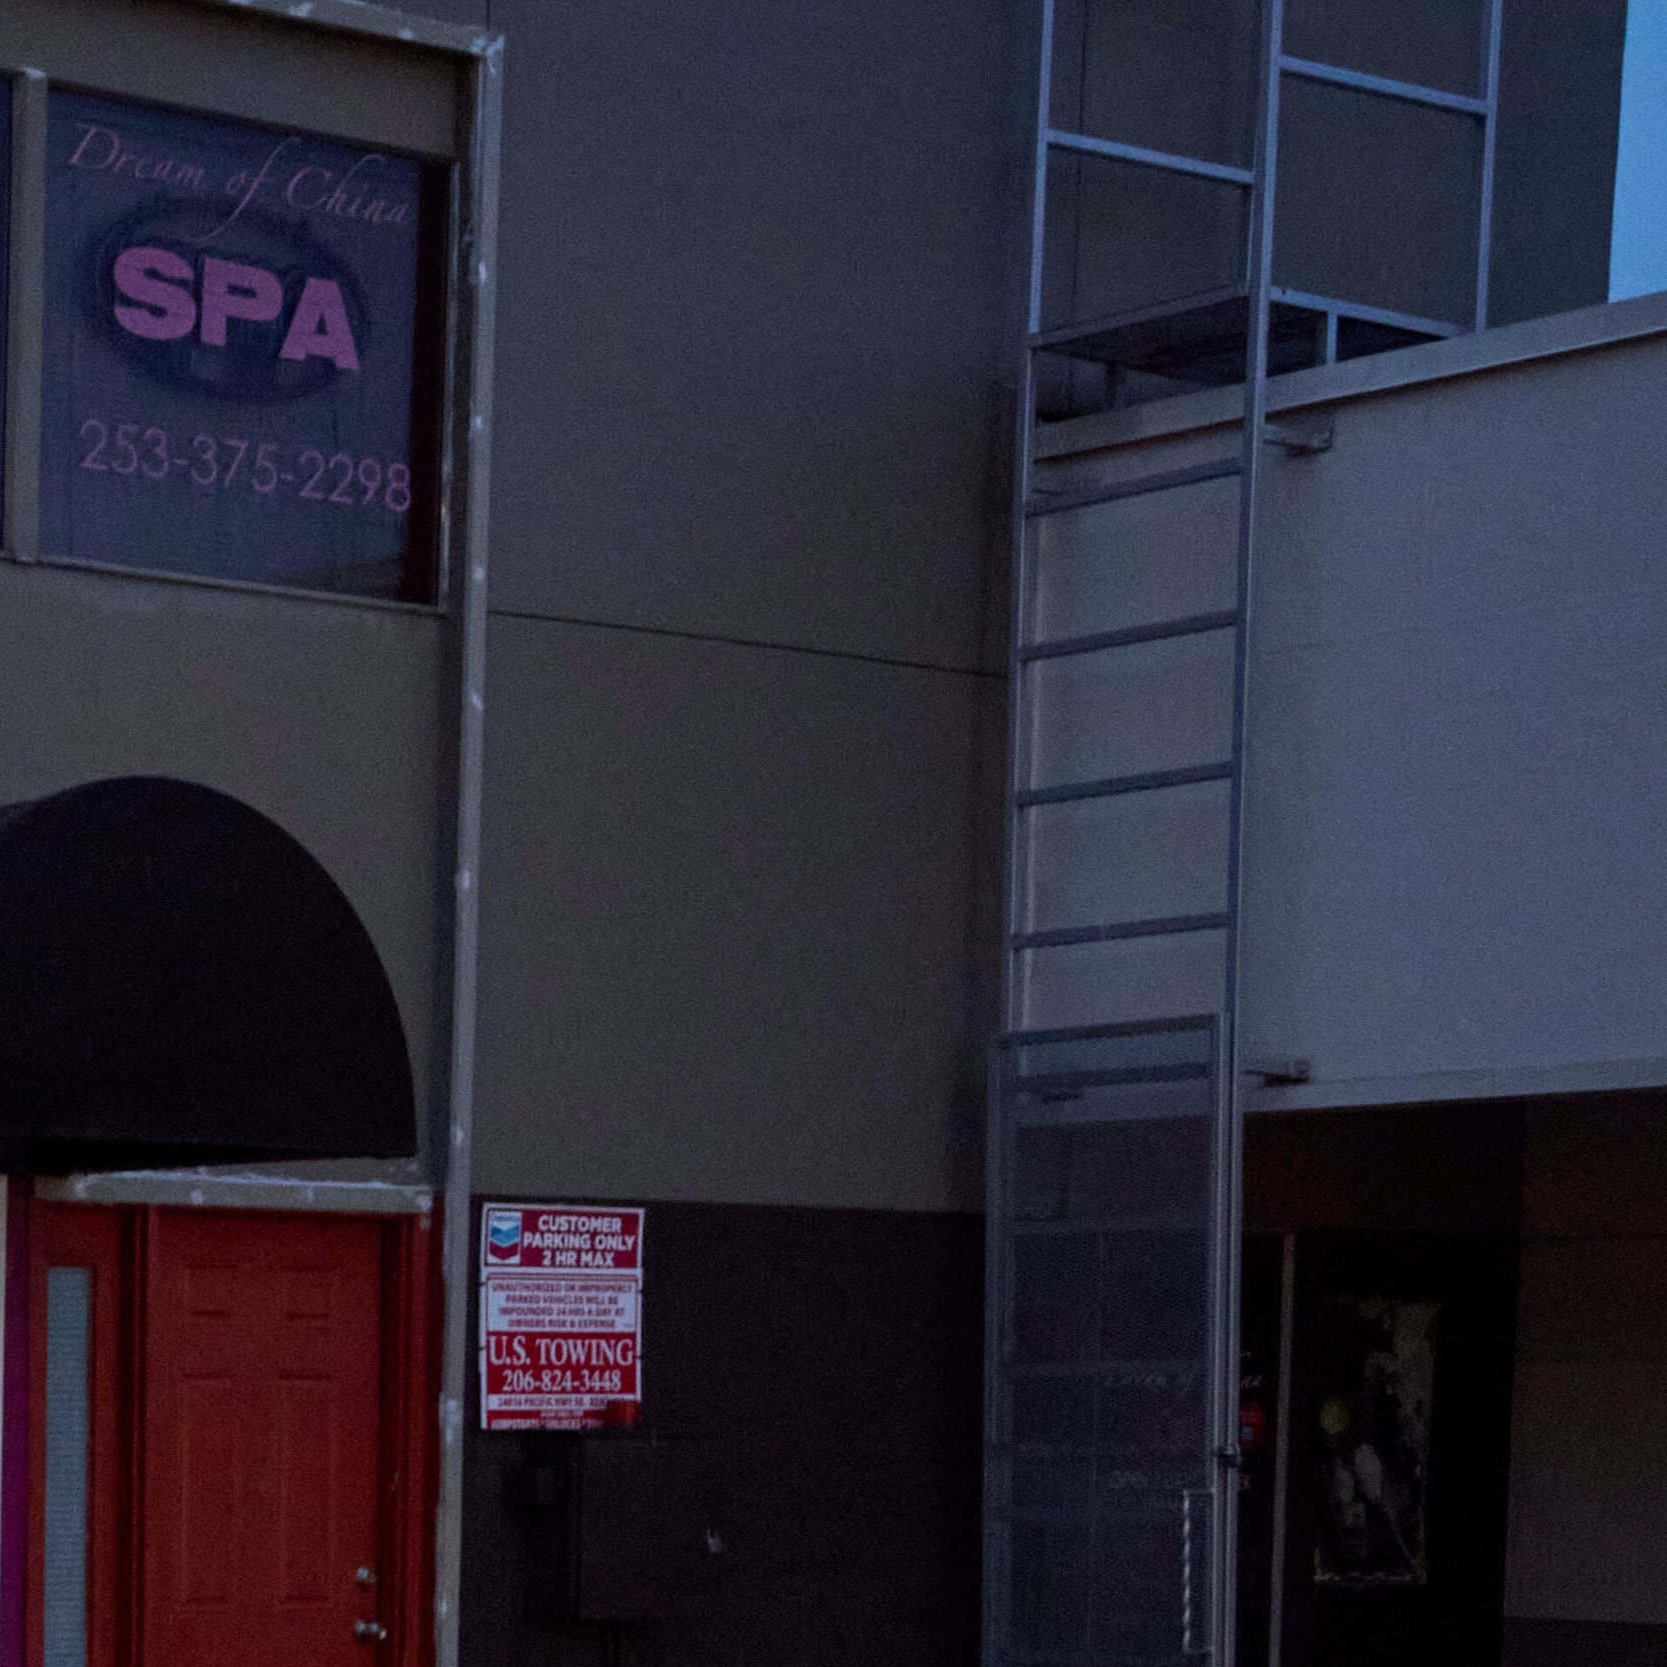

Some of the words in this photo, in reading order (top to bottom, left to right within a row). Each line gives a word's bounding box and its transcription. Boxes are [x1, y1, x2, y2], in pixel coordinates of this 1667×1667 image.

[69, 122, 204, 187] Dream
[286, 153, 410, 223] China
[113, 246, 361, 371] SPA
[79, 418, 412, 512] 253-375-2298
[538, 1215, 622, 1233] CUSTOMER
[523, 1231, 591, 1249] PARKING
[595, 1234, 635, 1251] ONLY
[543, 1251, 552, 1265] 2
[555, 1251, 578, 1266] HR
[581, 1252, 615, 1267] MAX
[488, 1335, 531, 1365] U.S.
[535, 1338, 634, 1367] TOWING
[502, 1369, 622, 1392] 206-824-3448
